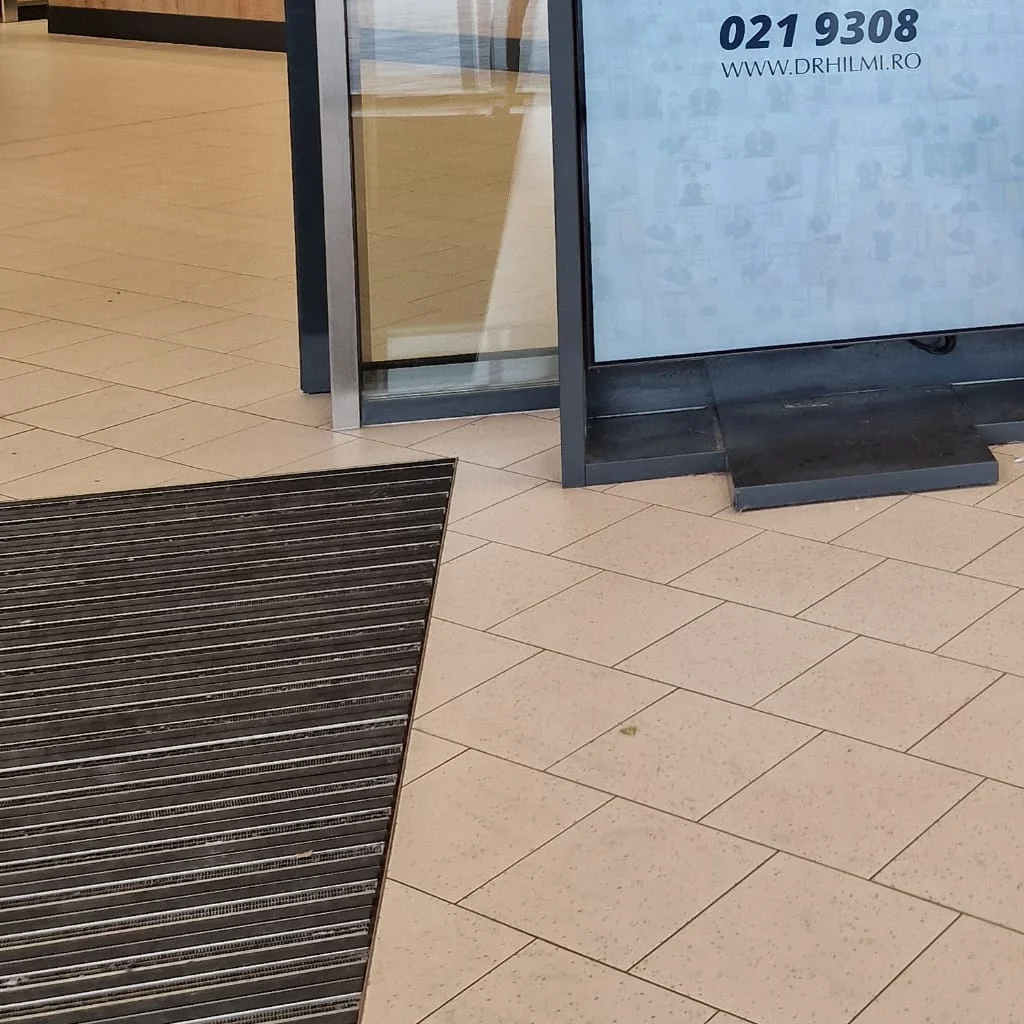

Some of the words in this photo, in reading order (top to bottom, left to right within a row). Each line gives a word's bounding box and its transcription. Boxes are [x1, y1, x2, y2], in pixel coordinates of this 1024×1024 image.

[719, 14, 799, 52] 021
[815, 9, 919, 48] 9308
[721, 52, 922, 79] WWW.DRHILMI.RO
